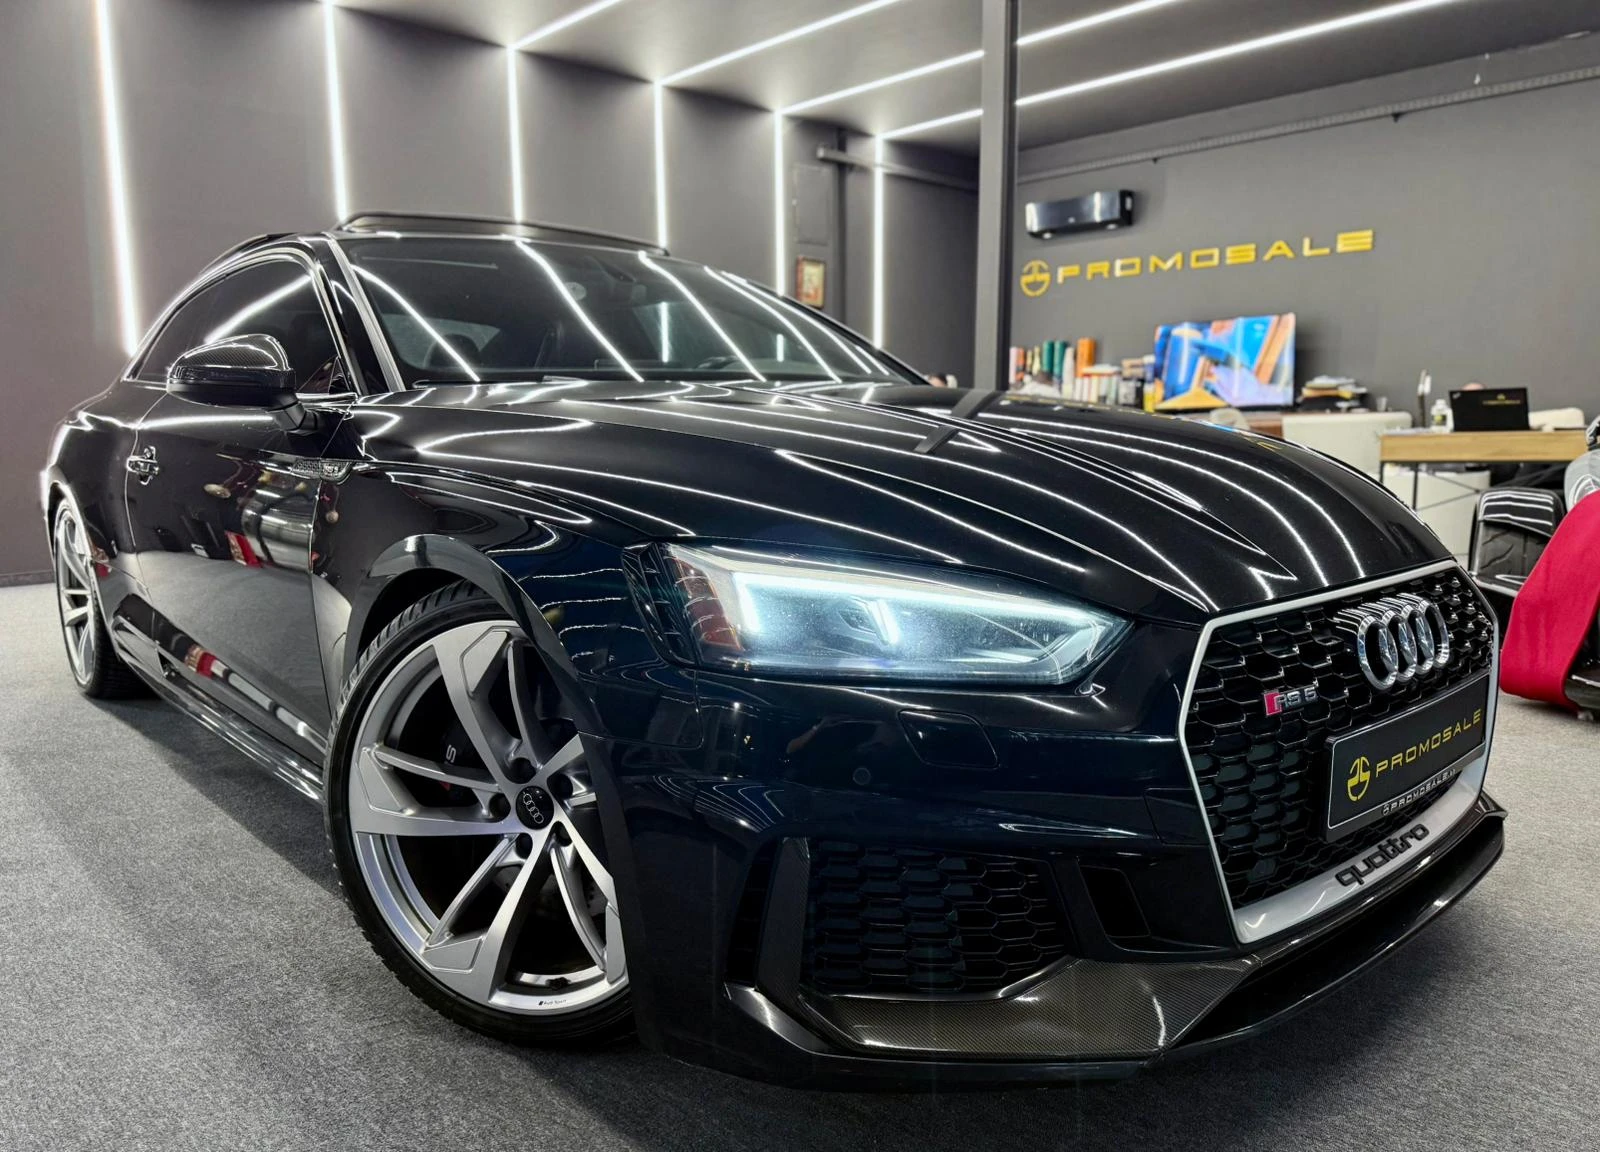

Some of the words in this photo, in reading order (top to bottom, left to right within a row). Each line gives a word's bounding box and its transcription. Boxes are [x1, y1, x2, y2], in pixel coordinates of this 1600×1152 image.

[1057, 230, 1374, 284] PROMOSALE
[1376, 708, 1481, 778] PROMOSALE
[1335, 823, 1429, 887] quattro
